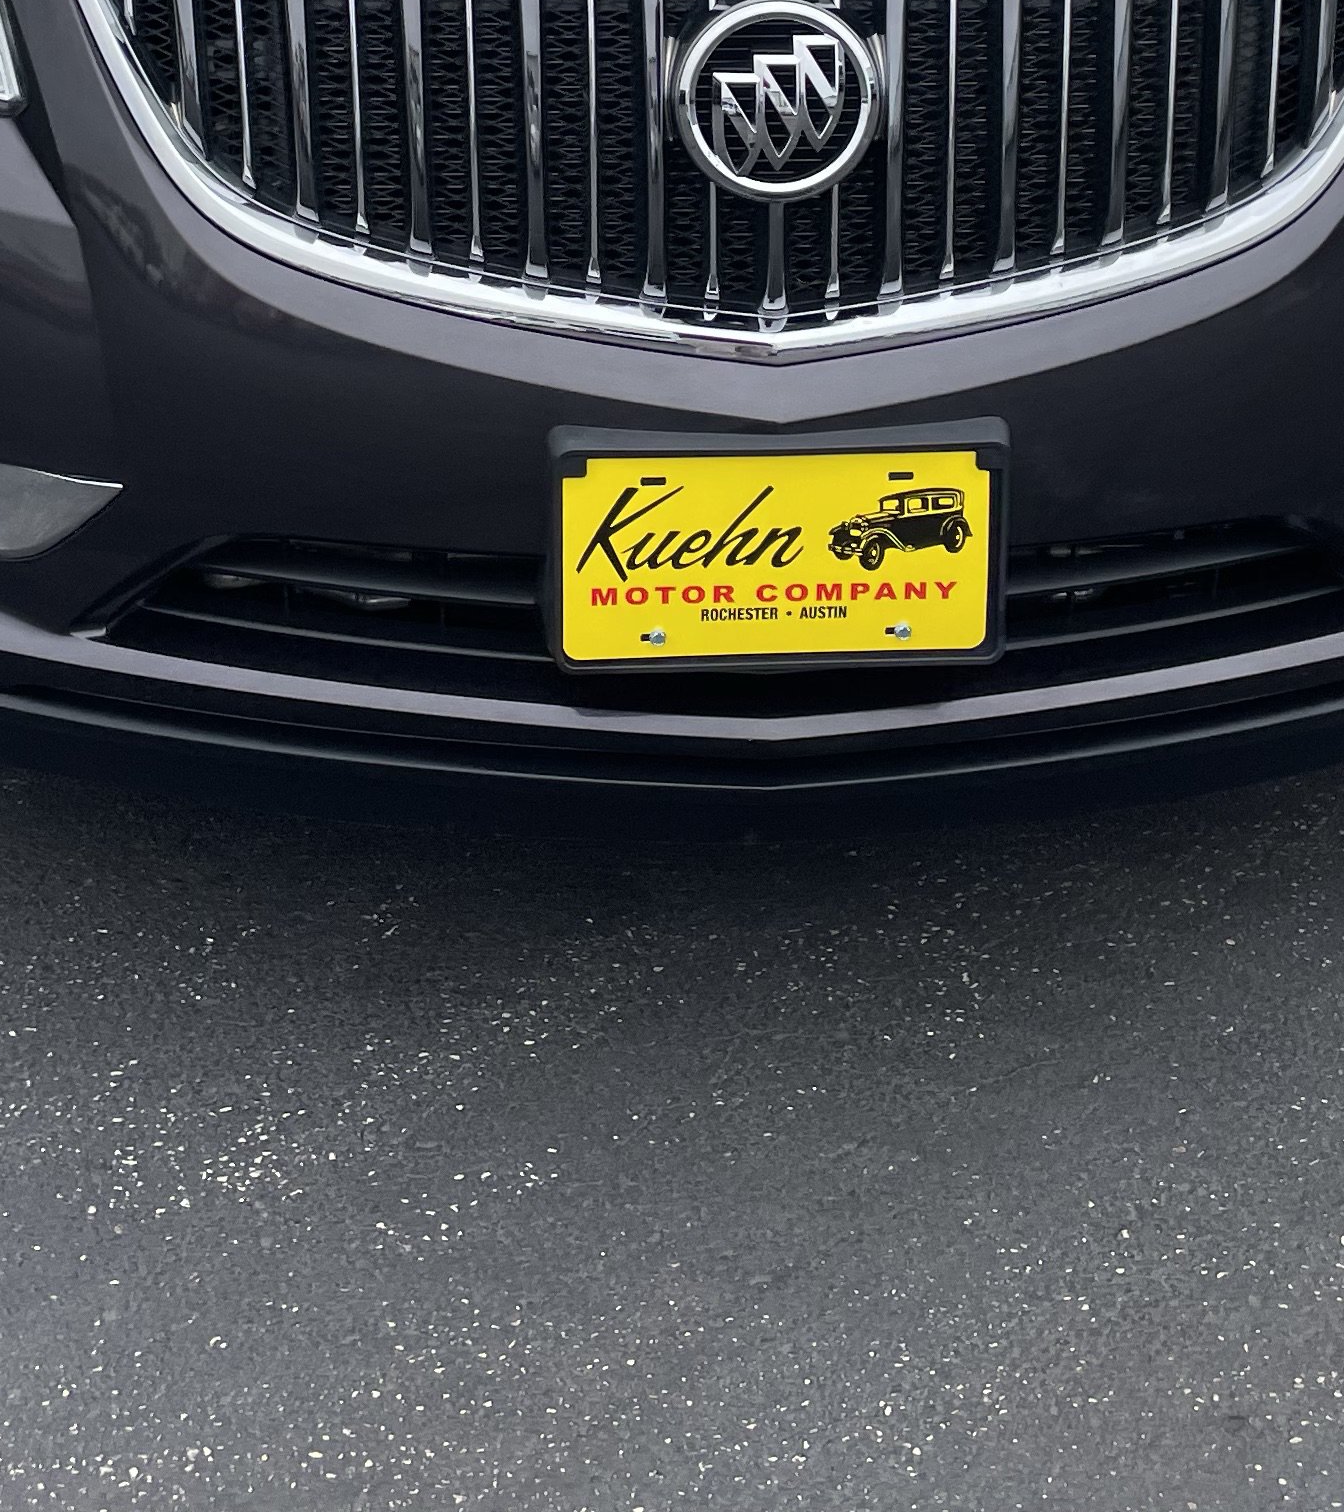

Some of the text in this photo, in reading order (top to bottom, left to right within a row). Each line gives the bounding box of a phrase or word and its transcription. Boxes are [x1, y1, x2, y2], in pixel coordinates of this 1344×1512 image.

[576, 484, 804, 582] Kuehn
[590, 580, 959, 606] MOTOR COMPANY
[700, 605, 848, 622] ROCHESTER AUSTIN
